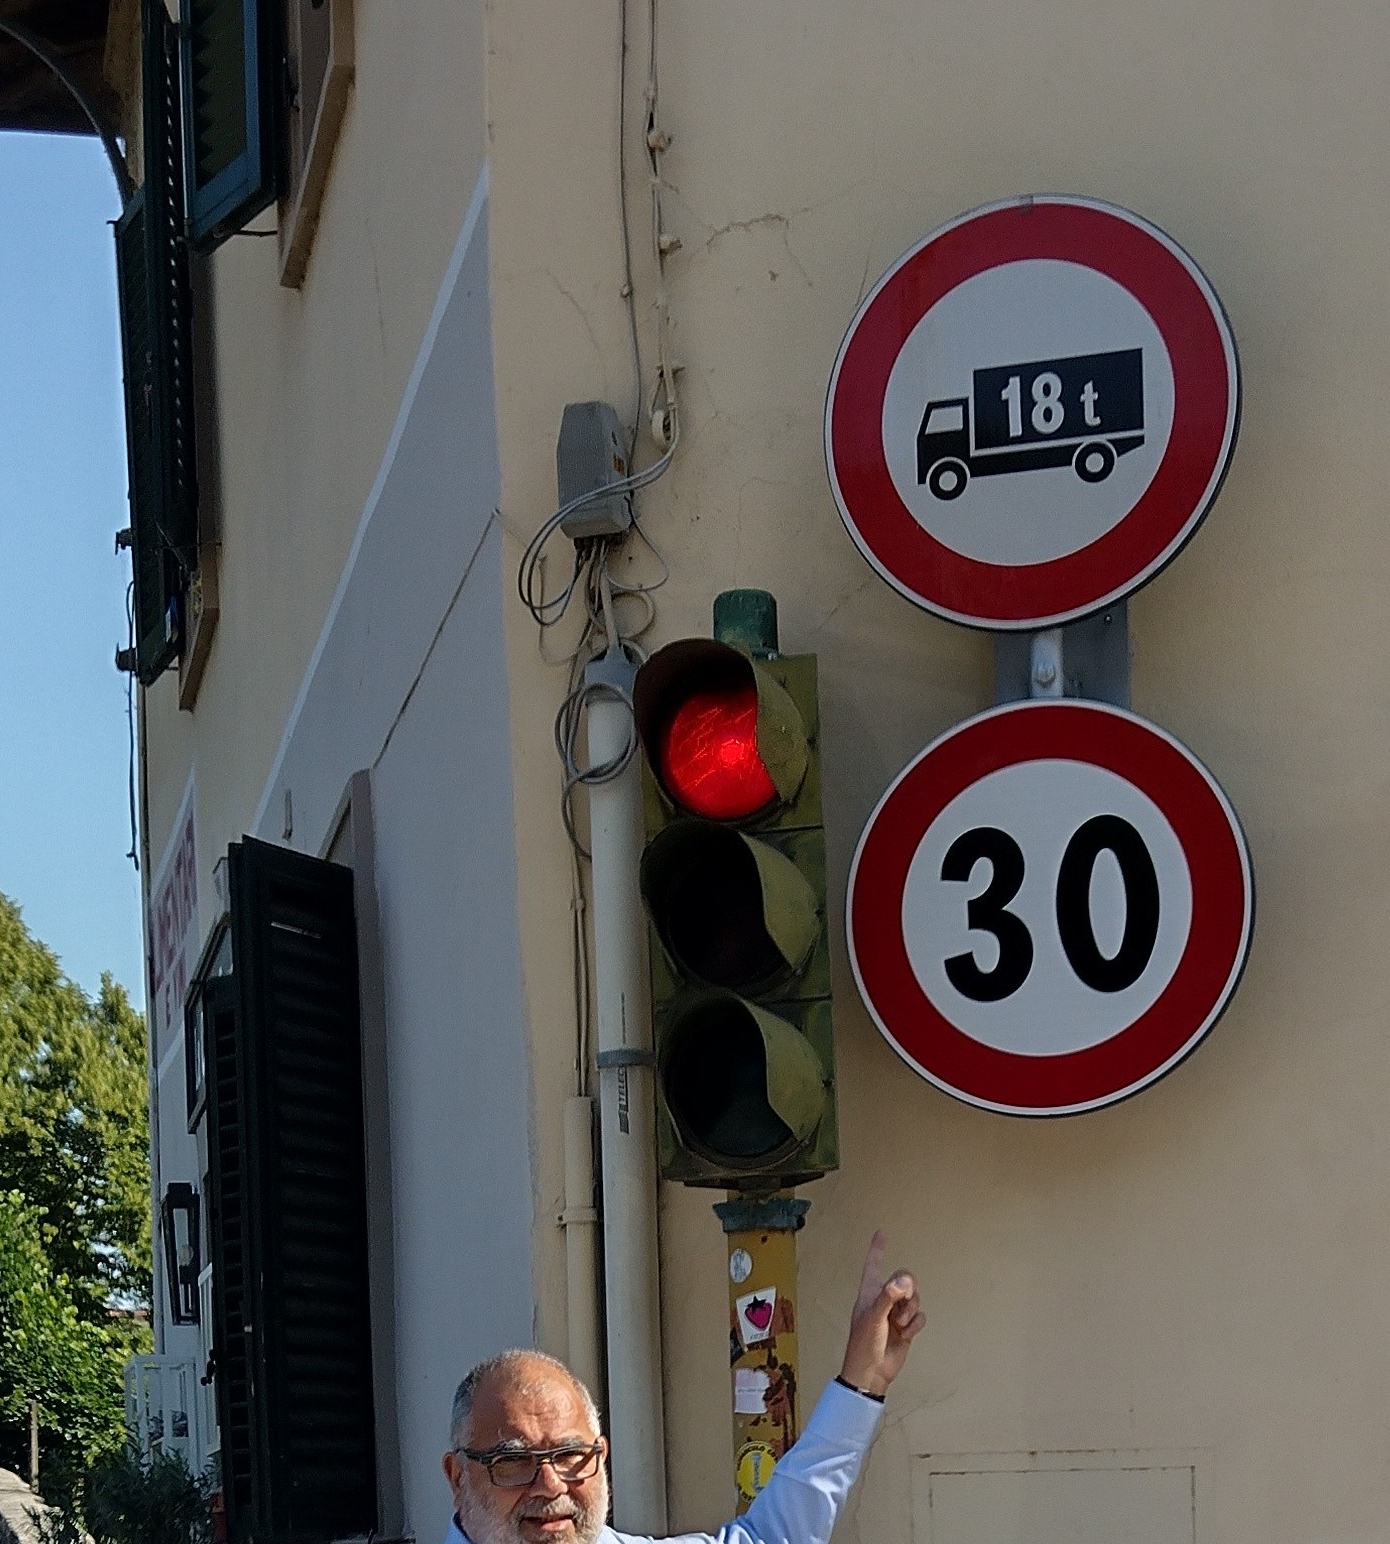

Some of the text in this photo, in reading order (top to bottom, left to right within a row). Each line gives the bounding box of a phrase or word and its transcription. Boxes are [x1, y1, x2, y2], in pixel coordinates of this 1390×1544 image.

[1001, 371, 1101, 438] 18 t
[940, 814, 1161, 1003] 30
